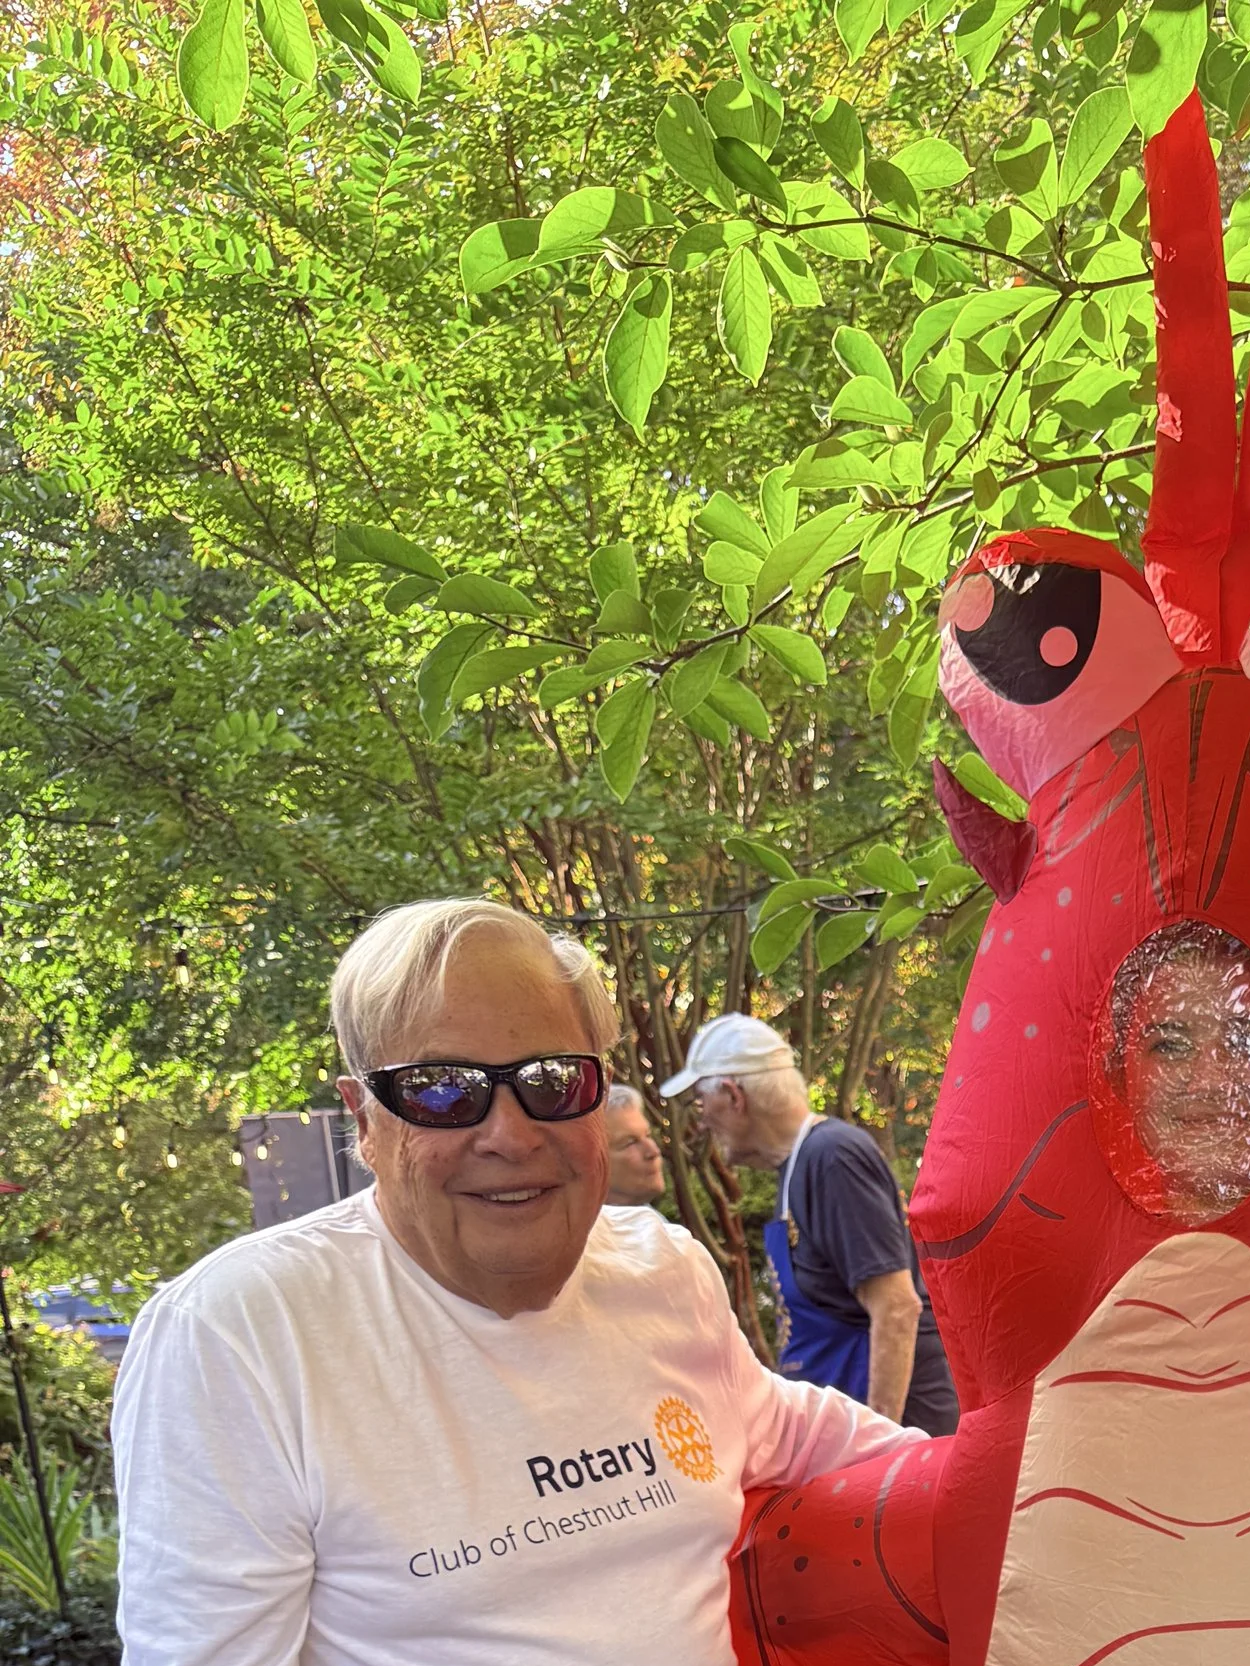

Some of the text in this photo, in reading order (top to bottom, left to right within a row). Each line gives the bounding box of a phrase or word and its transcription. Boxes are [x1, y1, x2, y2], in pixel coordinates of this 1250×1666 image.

[526, 1437, 658, 1498] Rotary
[408, 1479, 677, 1578] Club of Chestnut Hill
